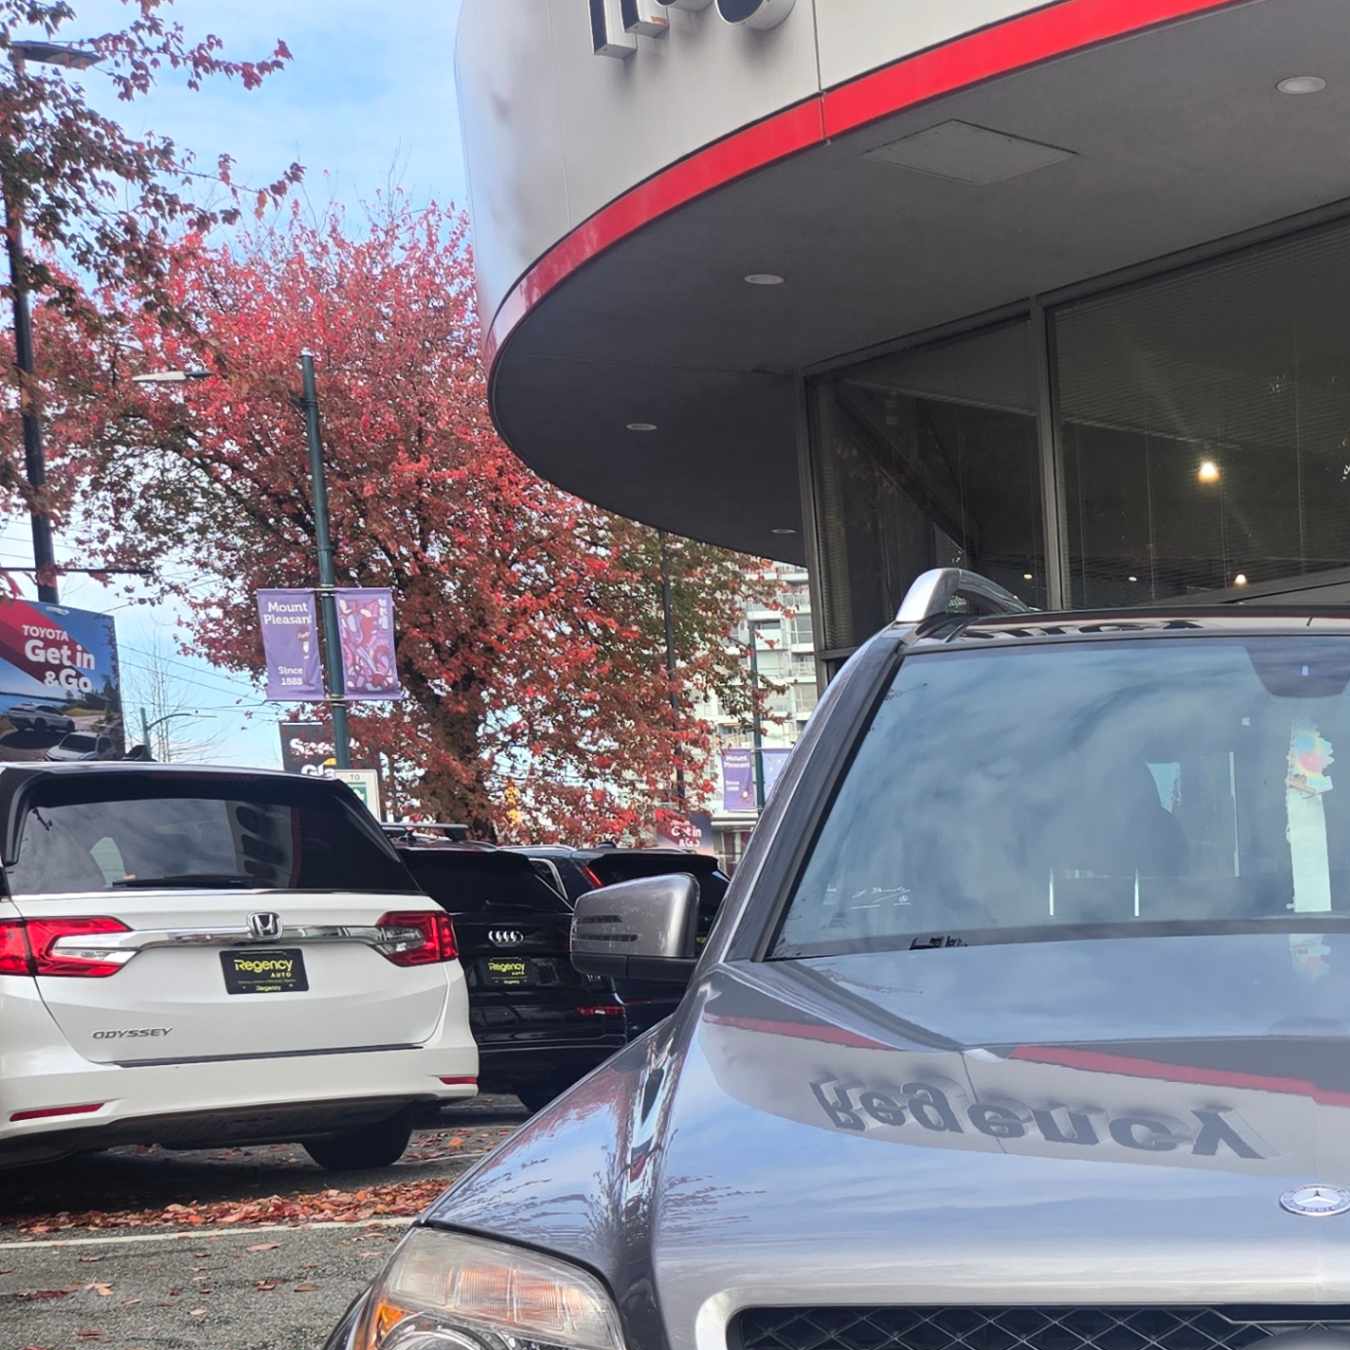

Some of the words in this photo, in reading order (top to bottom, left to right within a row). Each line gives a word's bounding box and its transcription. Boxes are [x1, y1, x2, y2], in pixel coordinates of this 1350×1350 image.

[267, 601, 308, 613] Mount
[22, 624, 70, 641] TOYOTA
[24, 639, 73, 667] Get
[75, 645, 96, 671] in
[234, 959, 293, 973] Regency
[488, 962, 525, 973] Regency
[92, 1027, 174, 1040] ODYSSEY
